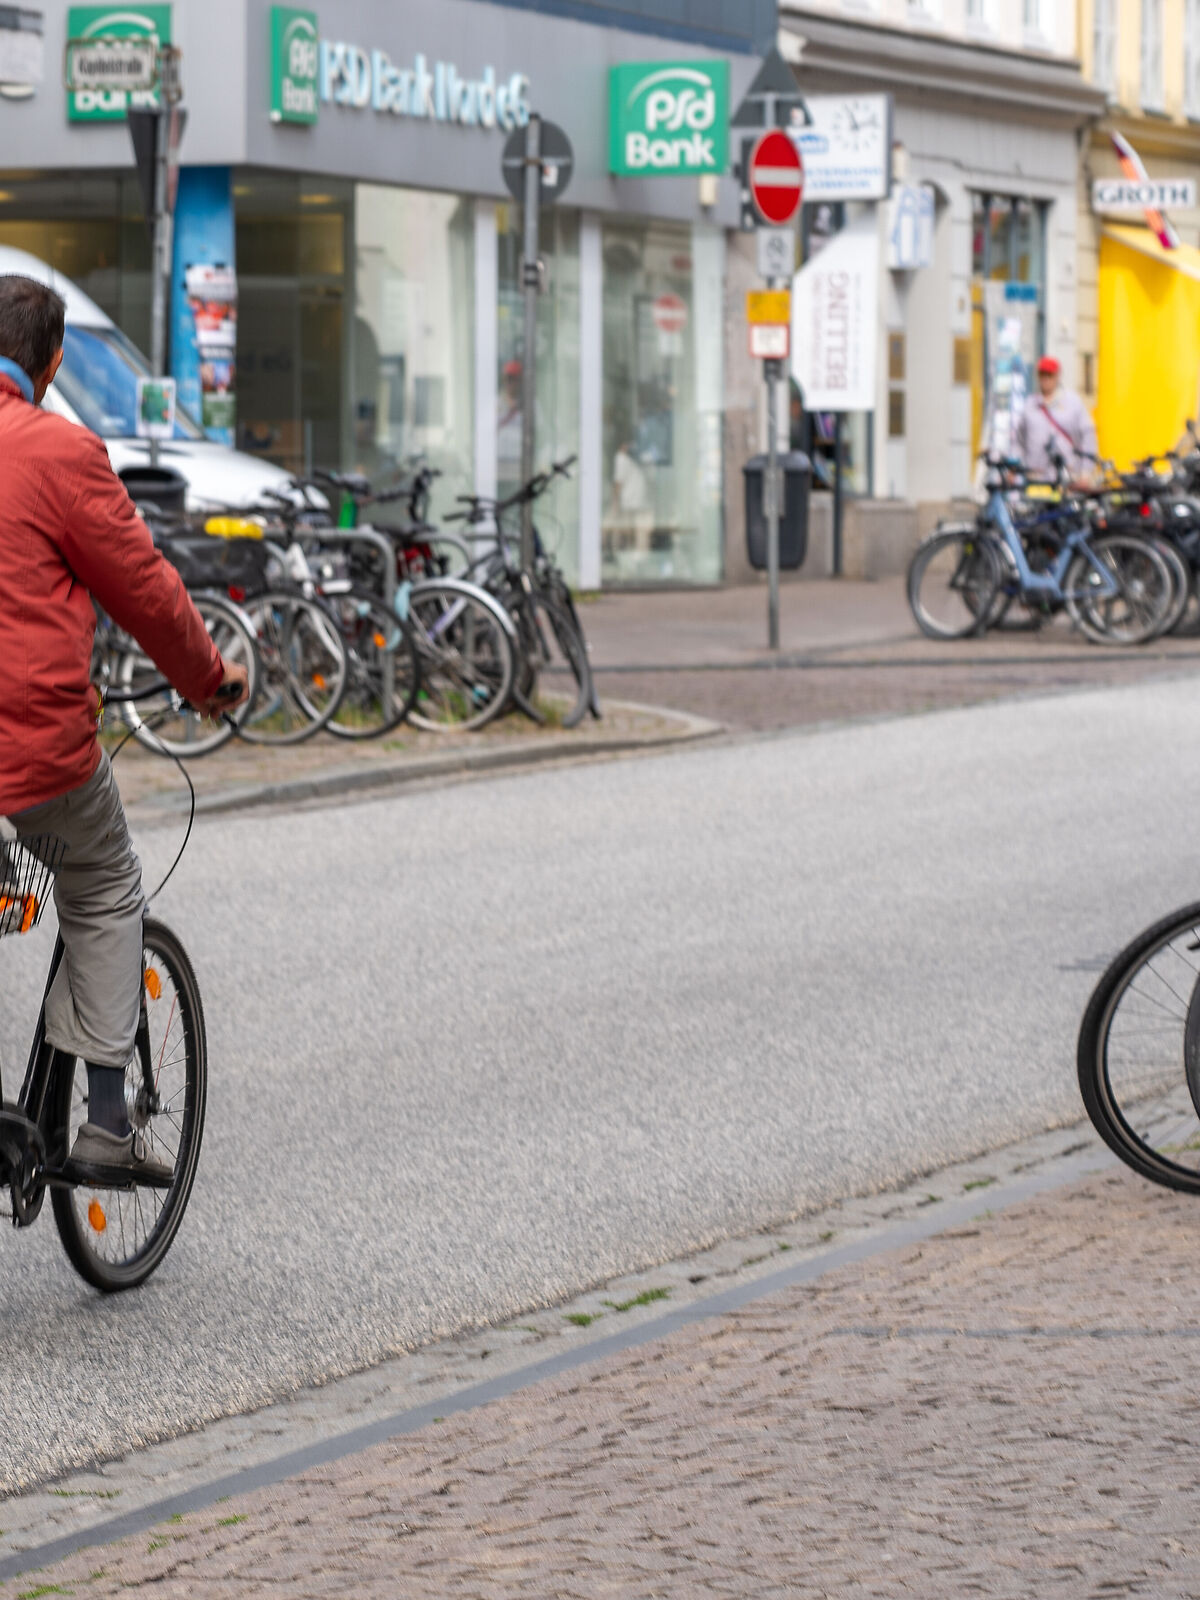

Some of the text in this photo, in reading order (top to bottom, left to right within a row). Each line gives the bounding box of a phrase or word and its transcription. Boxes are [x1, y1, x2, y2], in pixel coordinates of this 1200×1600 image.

[282, 77, 315, 113] Bank
[320, 40, 371, 107] PSD
[372, 48, 435, 118] Bank
[646, 88, 716, 132] psd
[626, 131, 716, 168] Bank
[1097, 185, 1189, 203] GROTH
[826, 270, 849, 391] BELLING
